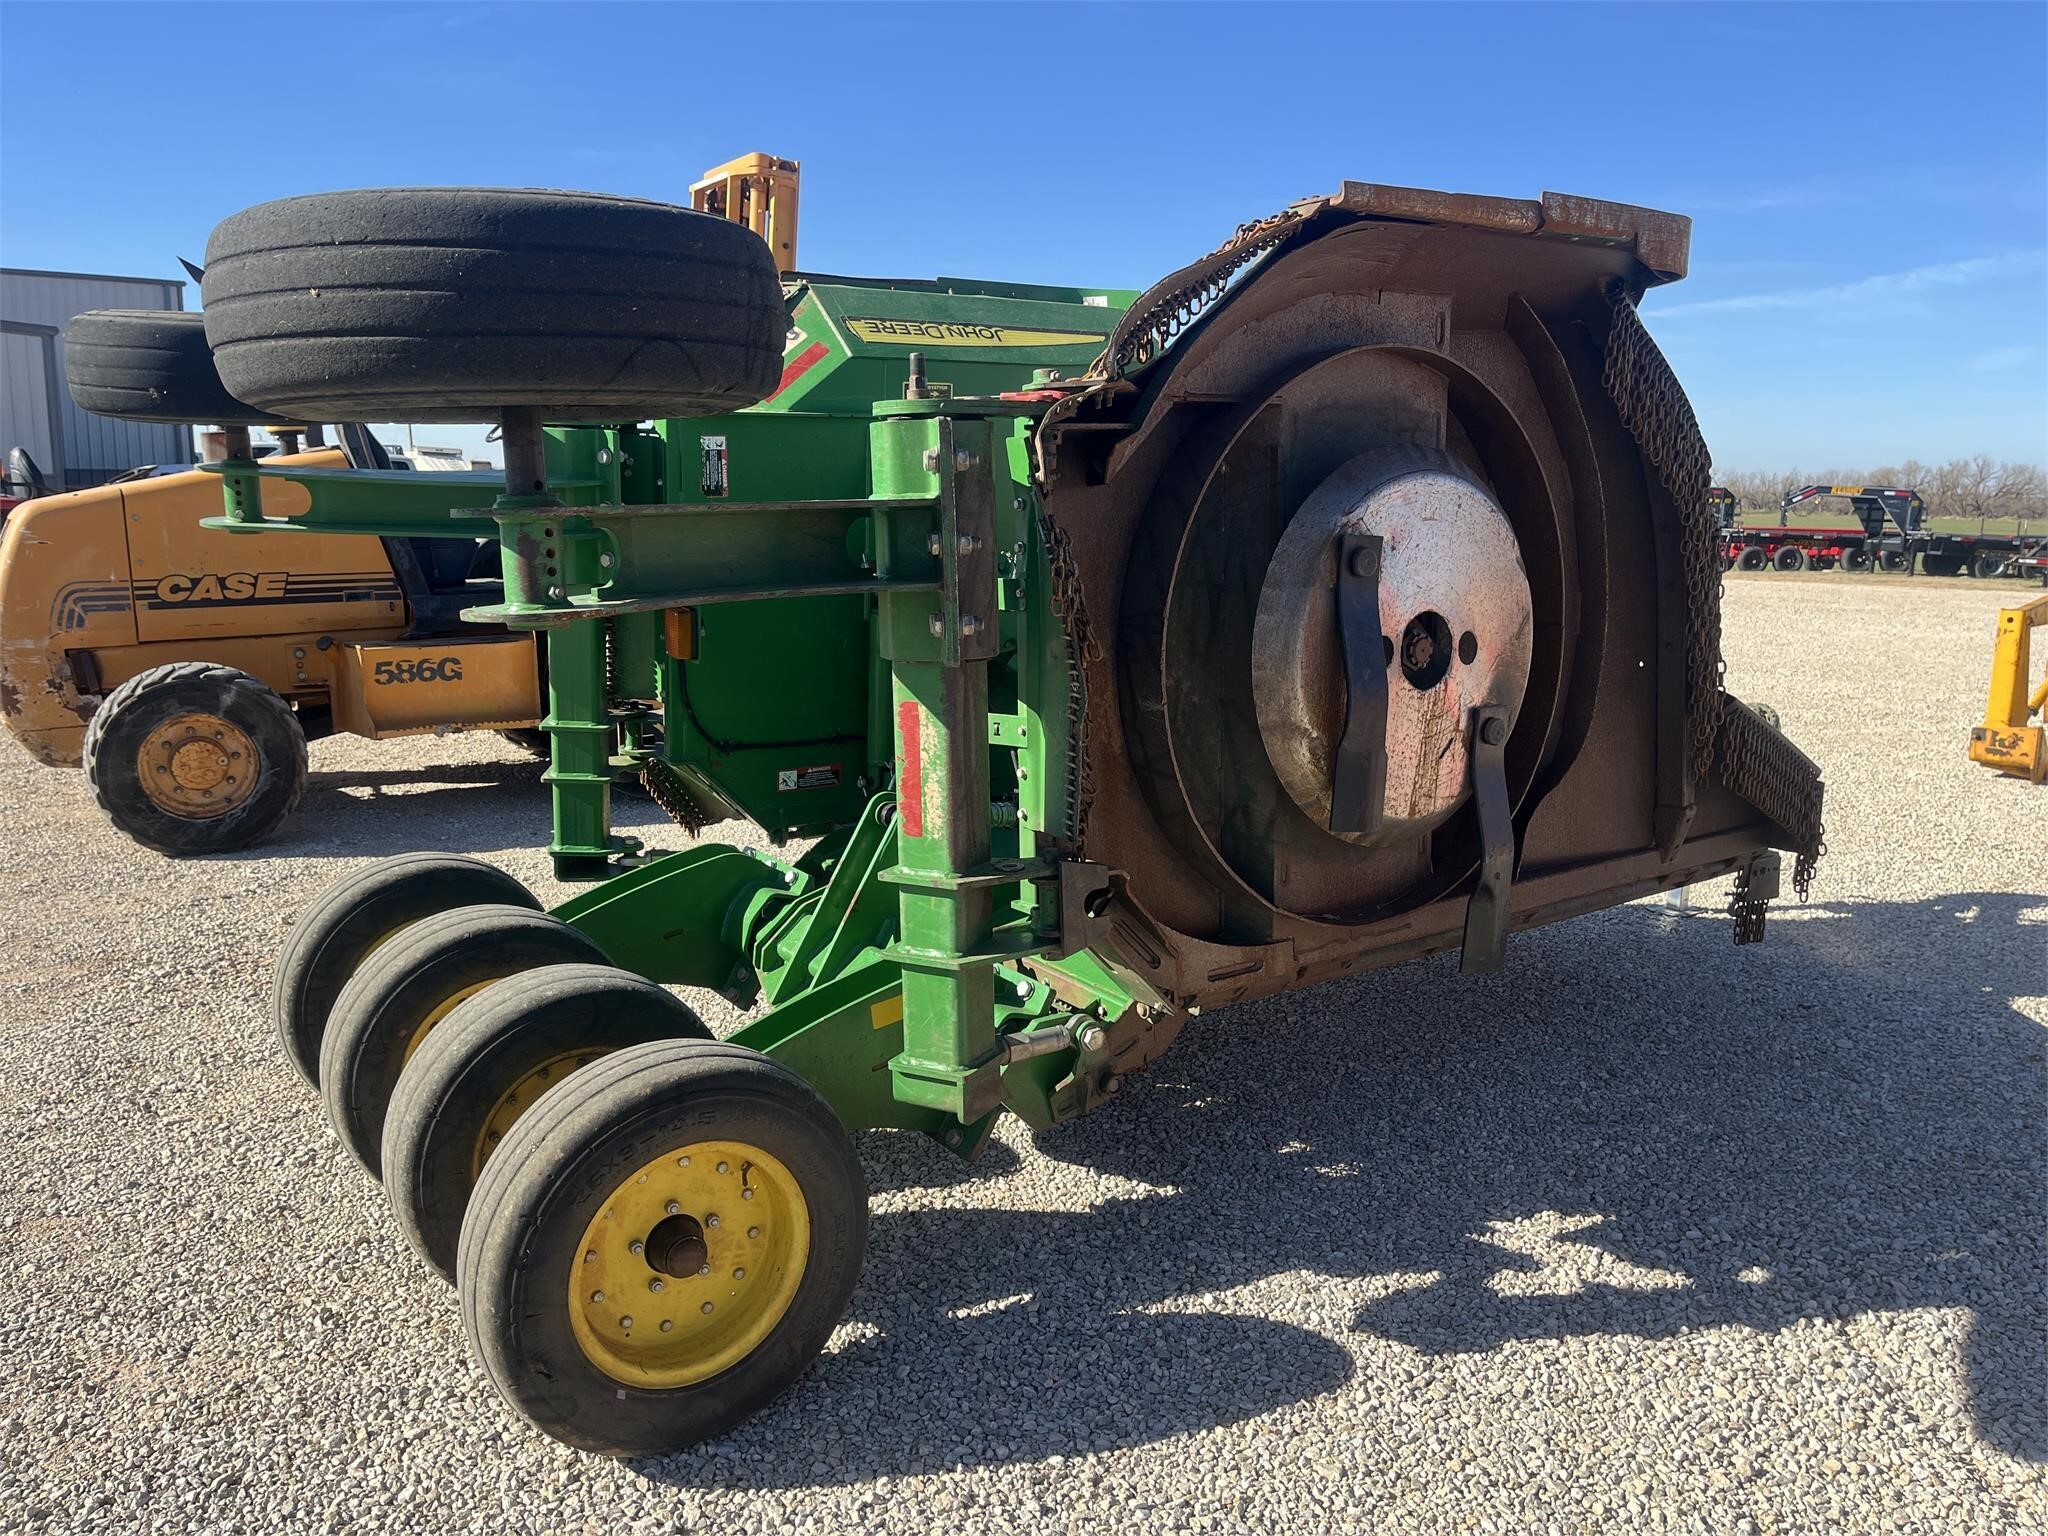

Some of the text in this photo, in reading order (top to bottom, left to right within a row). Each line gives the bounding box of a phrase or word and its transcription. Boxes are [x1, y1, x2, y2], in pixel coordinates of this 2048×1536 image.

[864, 321, 1004, 342] JOHN DEERE
[156, 572, 289, 600] CASE
[374, 657, 463, 686] 586G
